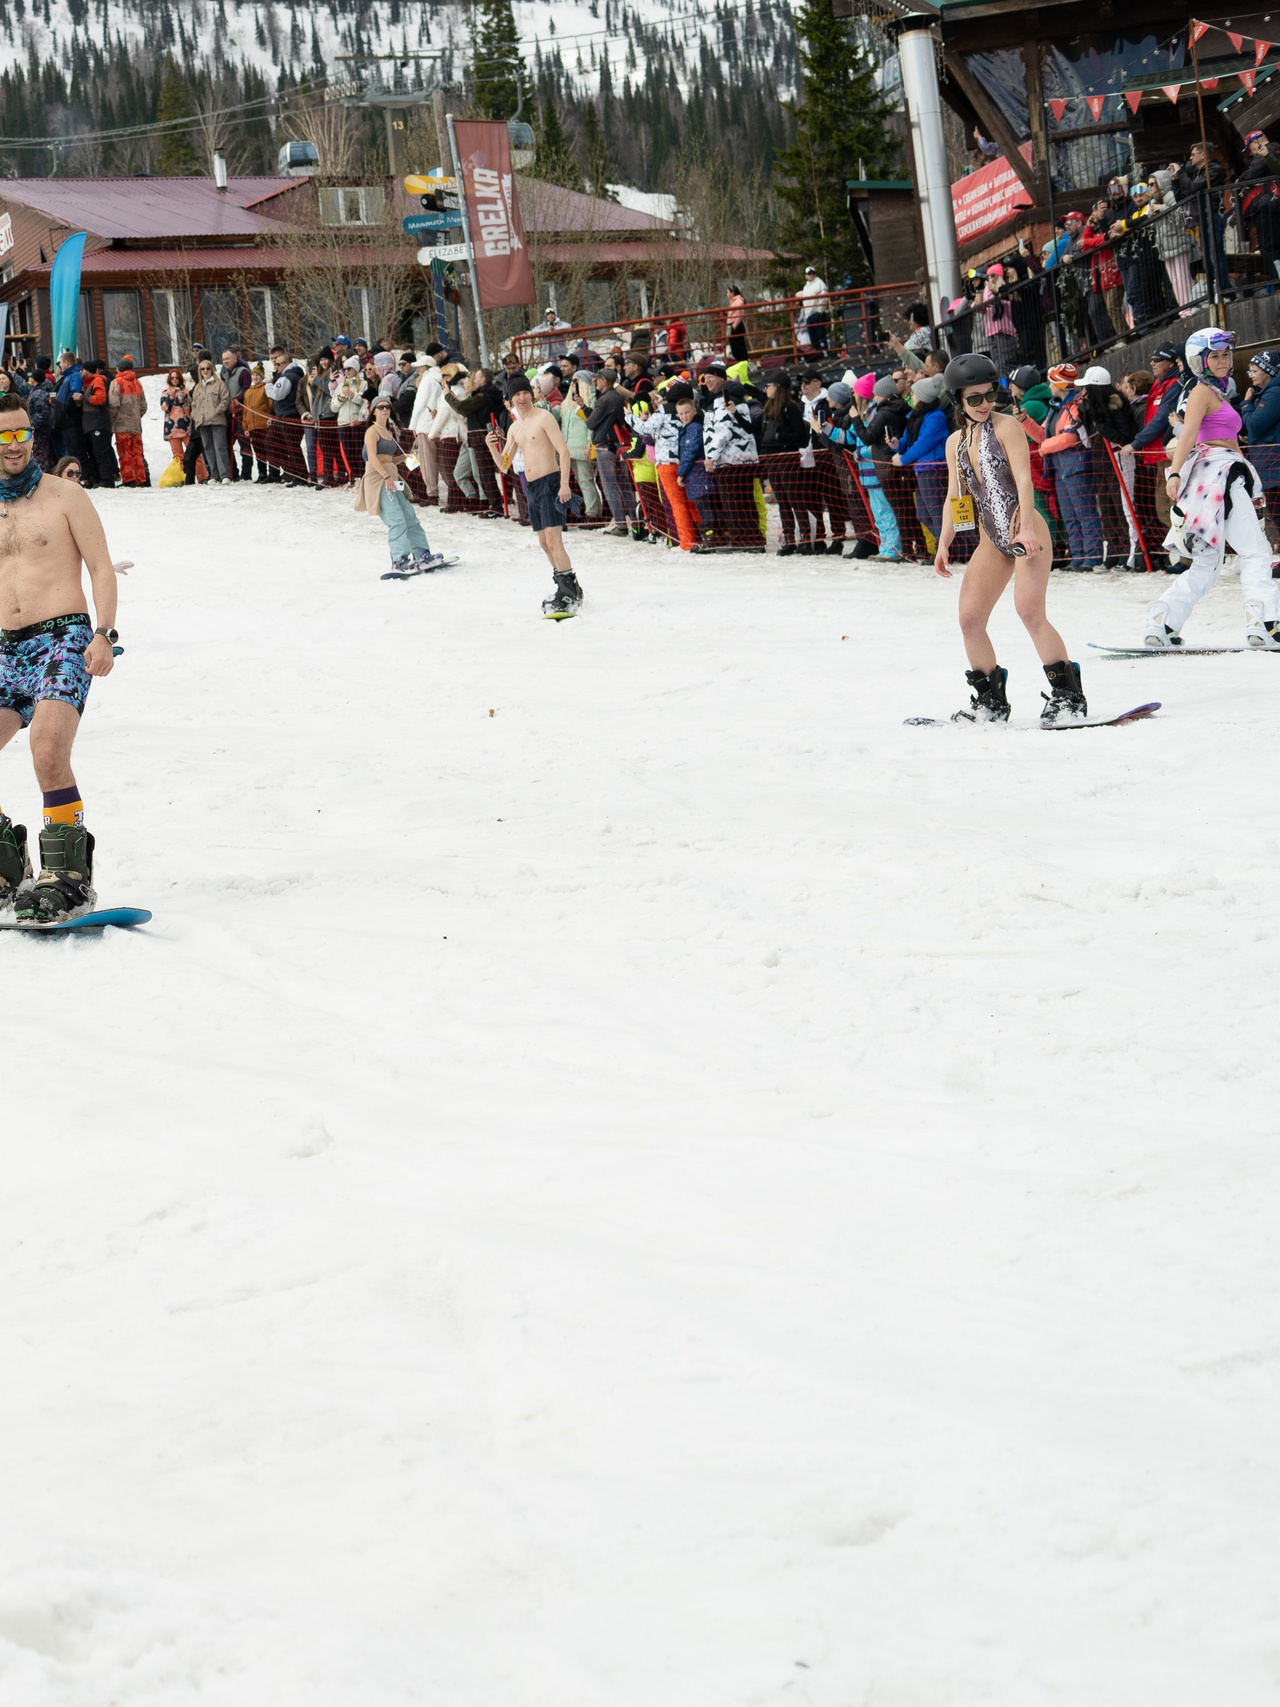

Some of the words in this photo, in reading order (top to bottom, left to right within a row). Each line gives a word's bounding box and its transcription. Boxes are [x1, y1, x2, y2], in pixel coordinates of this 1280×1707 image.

[392, 120, 404, 130] 13
[473, 168, 511, 257] GRELKA
[408, 219, 445, 230] Mammoth
[429, 244, 475, 259] ELIZABET
